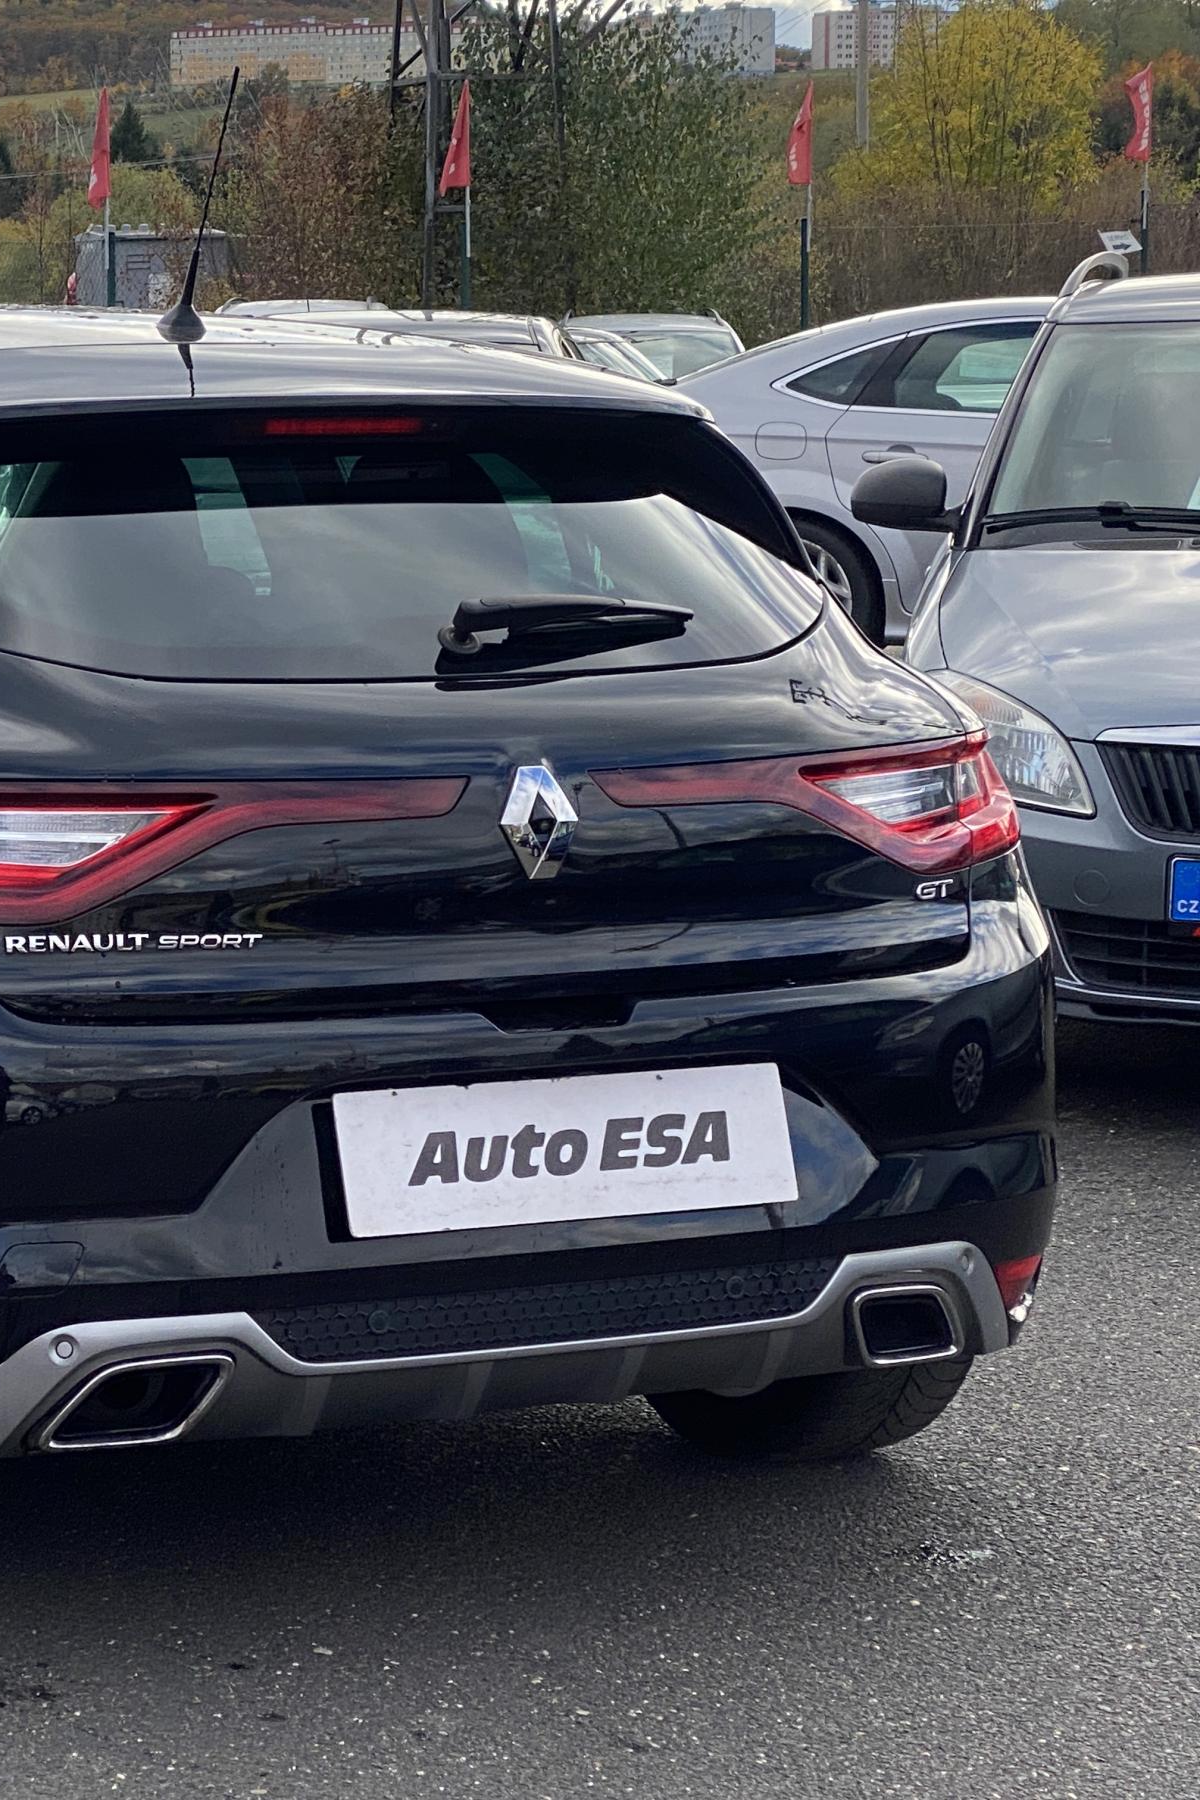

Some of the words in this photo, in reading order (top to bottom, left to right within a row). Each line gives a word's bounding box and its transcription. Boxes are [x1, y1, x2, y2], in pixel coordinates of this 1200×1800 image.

[916, 879, 954, 899] GT
[1177, 899, 1199, 913] CZ
[4, 933, 149, 953] RENAULT
[158, 934, 263, 949] SPORT
[408, 1124, 589, 1187] Auto
[599, 1110, 731, 1172] ESA
